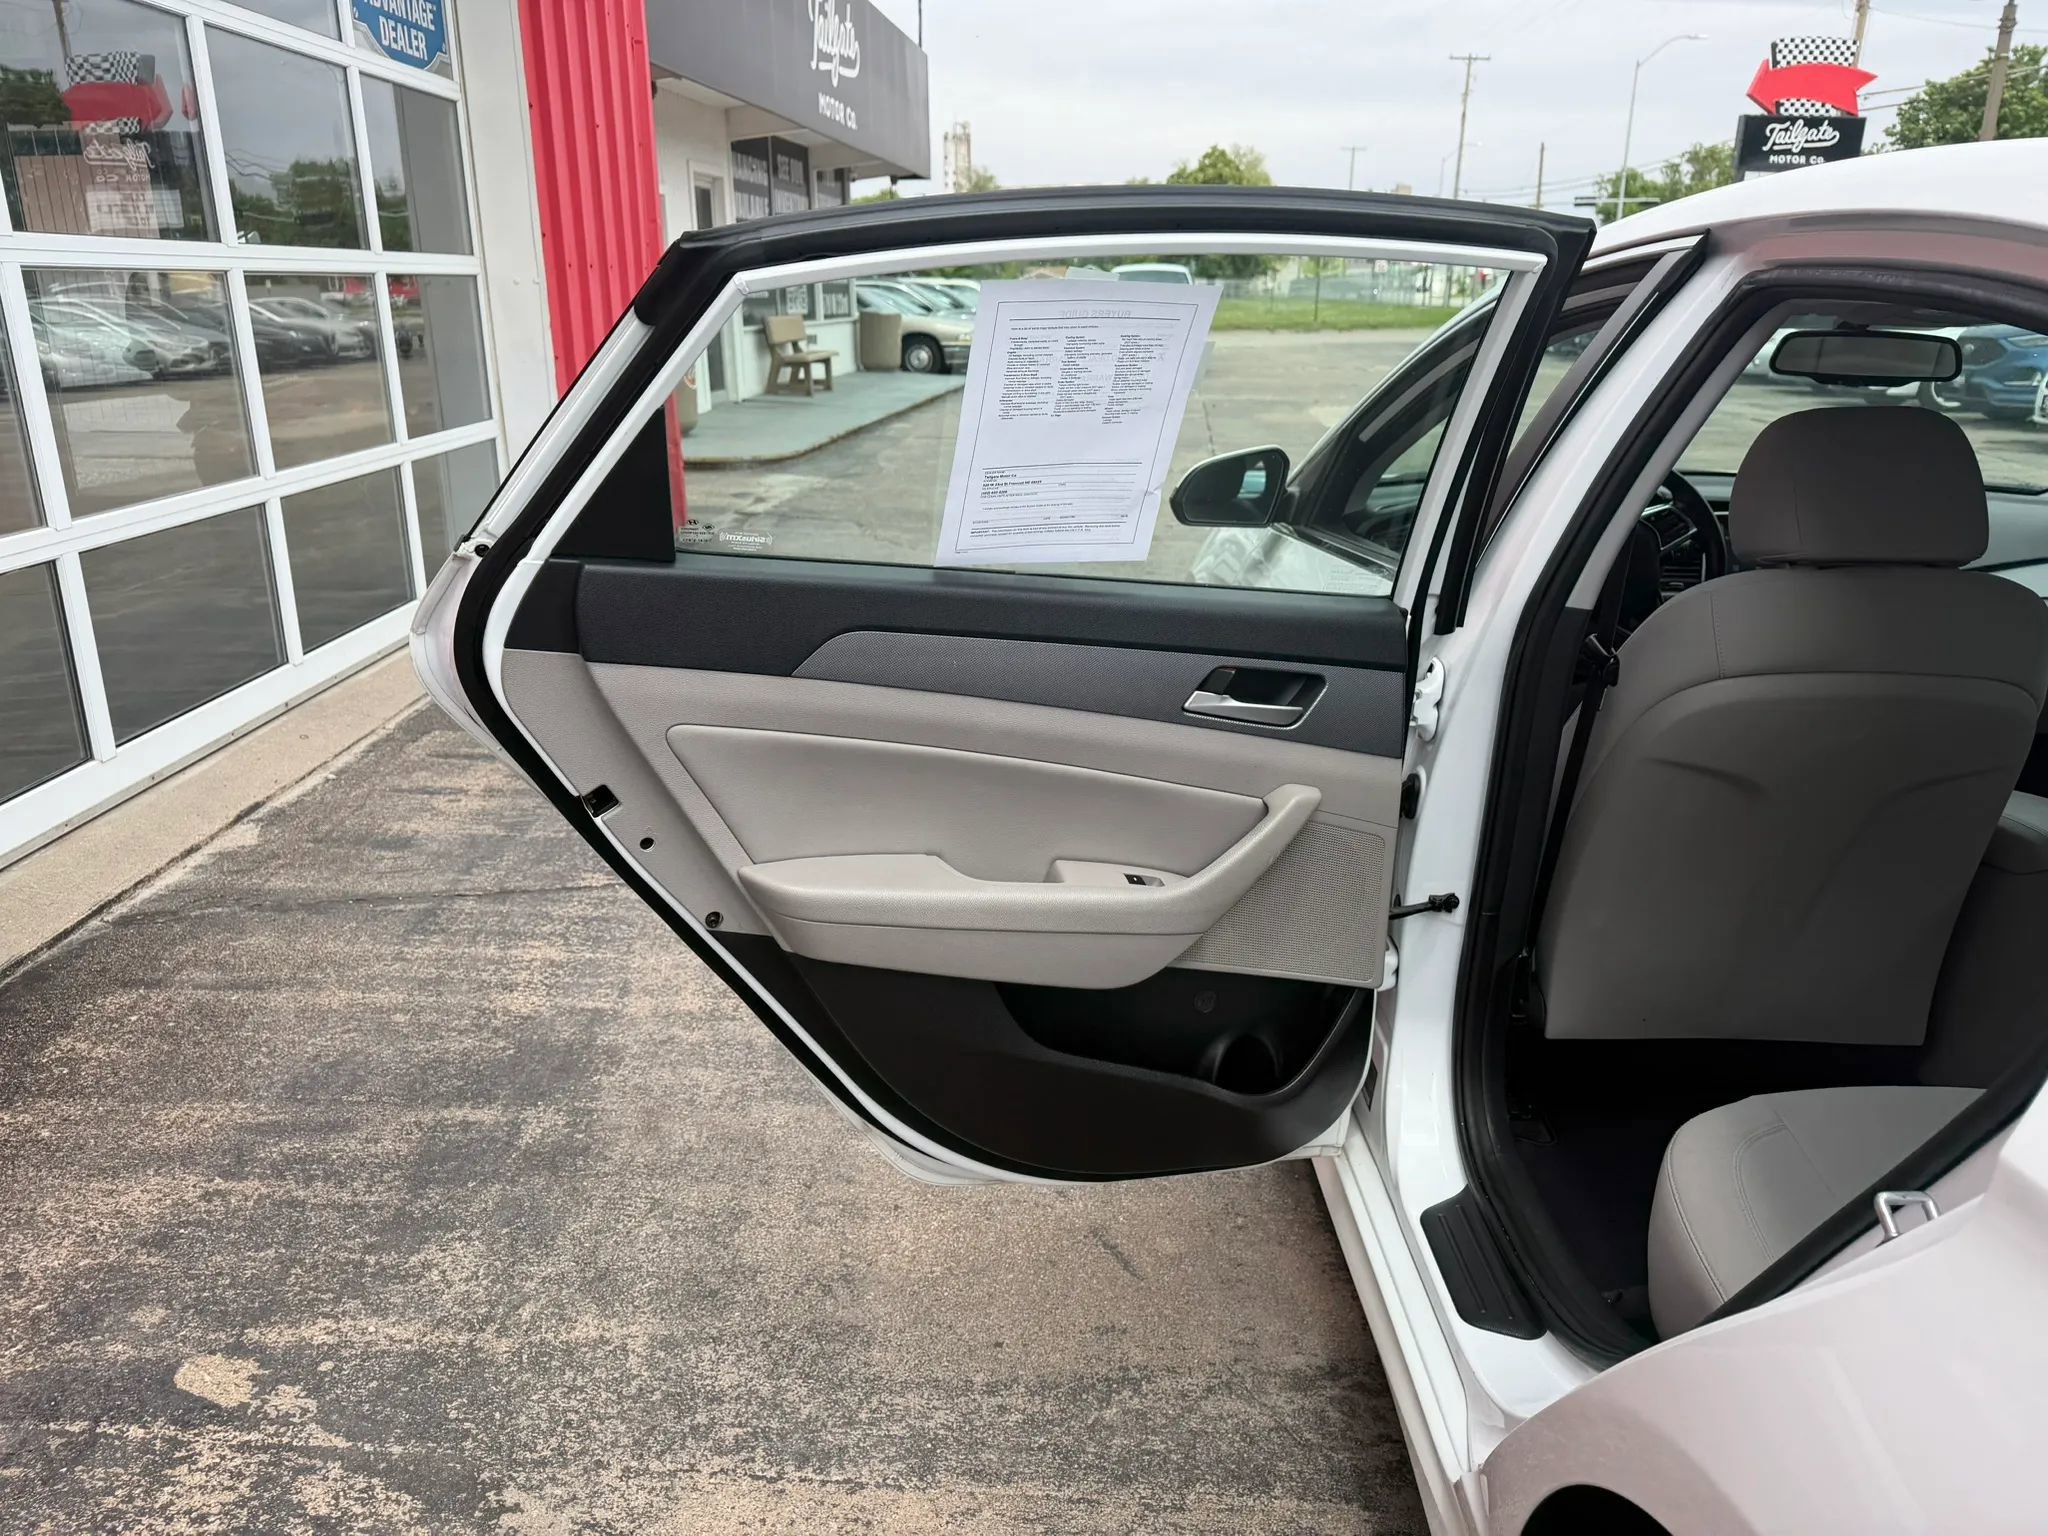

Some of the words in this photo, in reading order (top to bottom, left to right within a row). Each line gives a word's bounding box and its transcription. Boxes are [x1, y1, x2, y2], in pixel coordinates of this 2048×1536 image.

[364, 0, 436, 31] ANTAGE
[378, 15, 428, 61] DEALER
[818, 92, 845, 126] MOTOR
[1762, 119, 1840, 153] Tailgate
[1769, 154, 1806, 165] MOTOR
